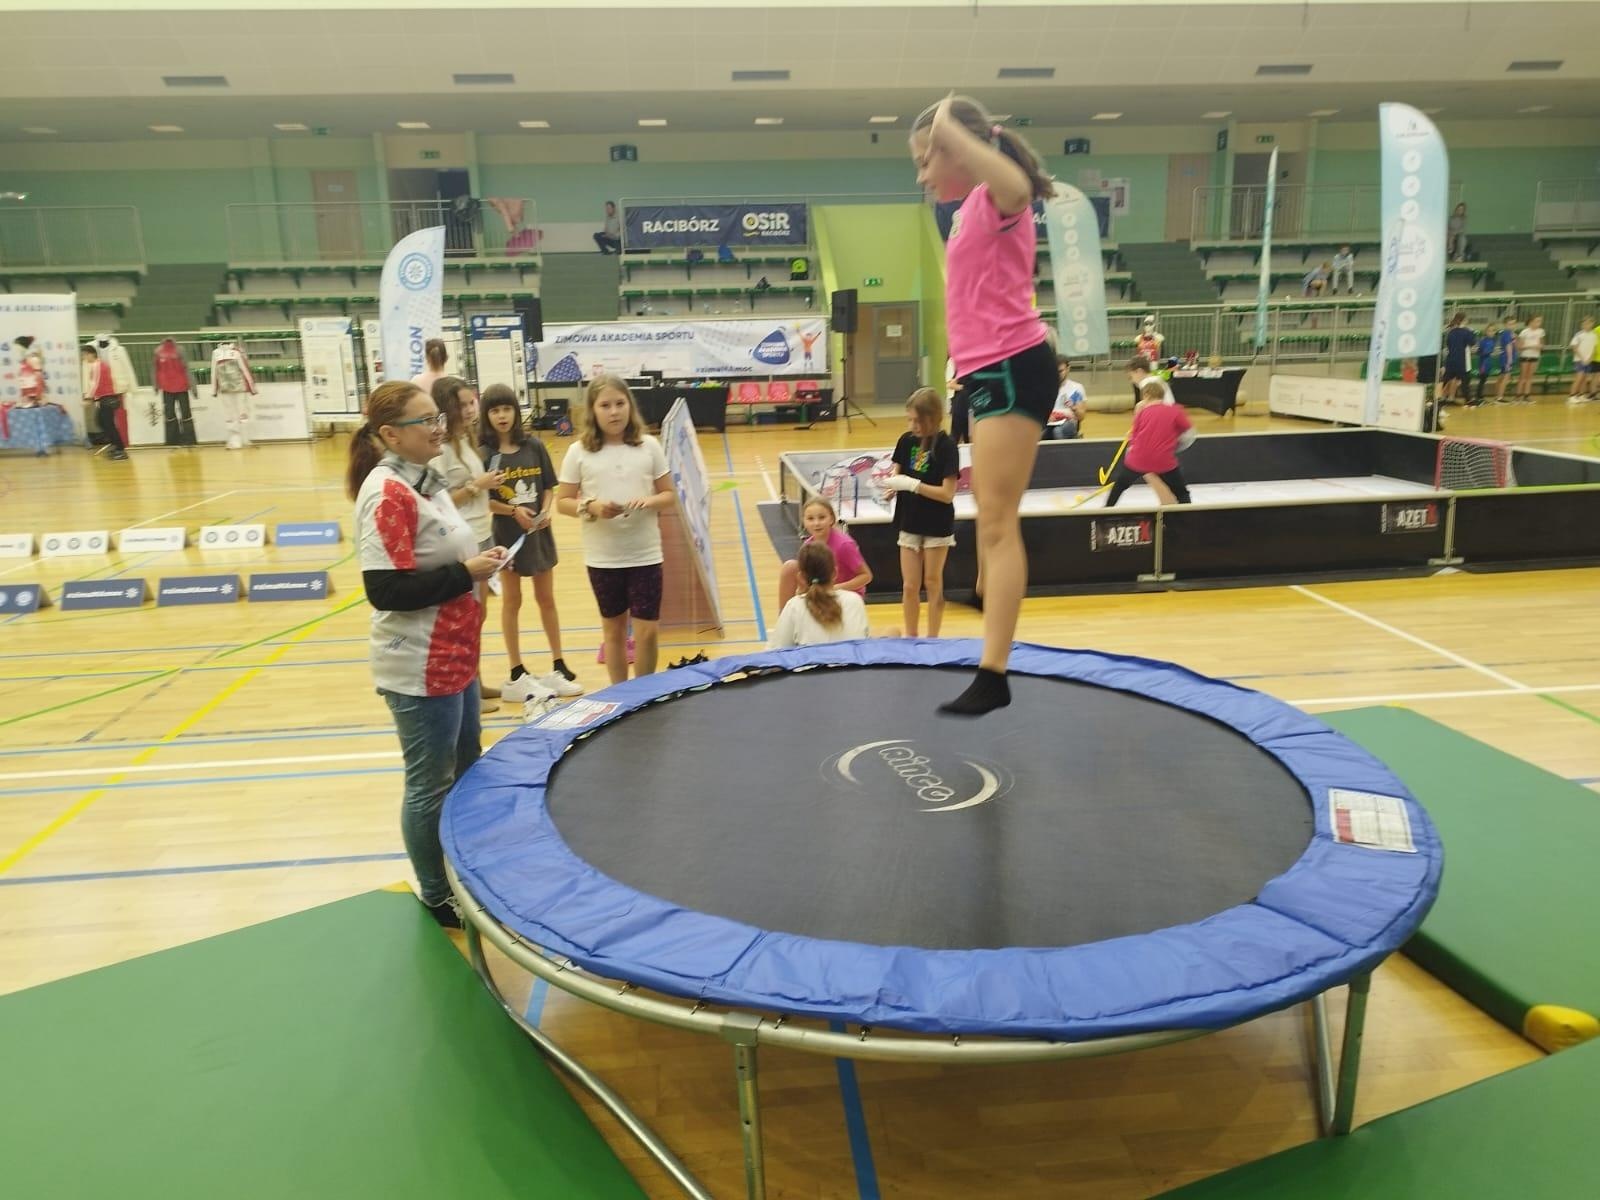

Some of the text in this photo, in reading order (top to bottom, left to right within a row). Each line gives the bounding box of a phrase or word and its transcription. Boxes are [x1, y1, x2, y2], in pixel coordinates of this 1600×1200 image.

[642, 216, 720, 234] RACIBÓRZ
[555, 331, 695, 344] ZIMOWA AKADEMIA SPORTU
[409, 326, 425, 376] HLON
